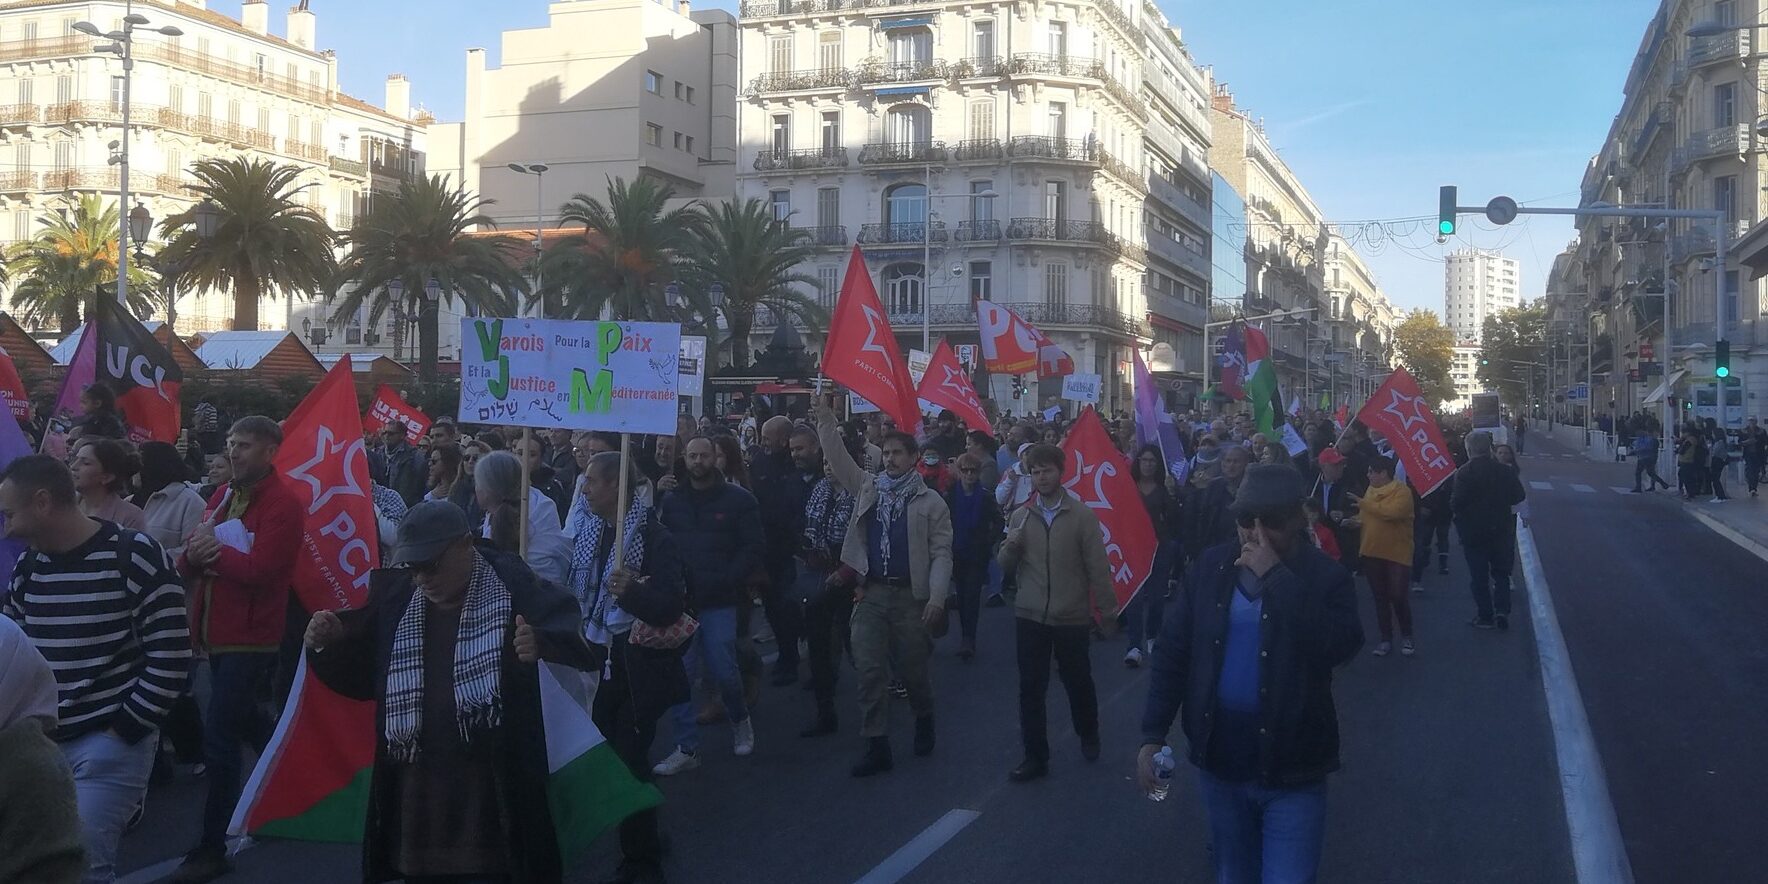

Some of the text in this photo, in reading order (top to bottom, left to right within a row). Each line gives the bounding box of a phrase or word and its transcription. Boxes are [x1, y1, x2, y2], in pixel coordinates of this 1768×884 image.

[474, 319, 544, 362] Varois
[555, 335, 577, 347] Pour
[581, 337, 590, 348] la
[597, 320, 653, 367] Paix
[106, 341, 171, 403] UCL
[468, 365, 479, 377] Et
[481, 365, 491, 378] la
[487, 354, 556, 400] Justice
[557, 391, 570, 402] en
[569, 367, 675, 415] Méditerranée
[855, 359, 876, 375] PARTI
[1412, 428, 1449, 470] PCF
[320, 566, 352, 609] FRANÇAI
